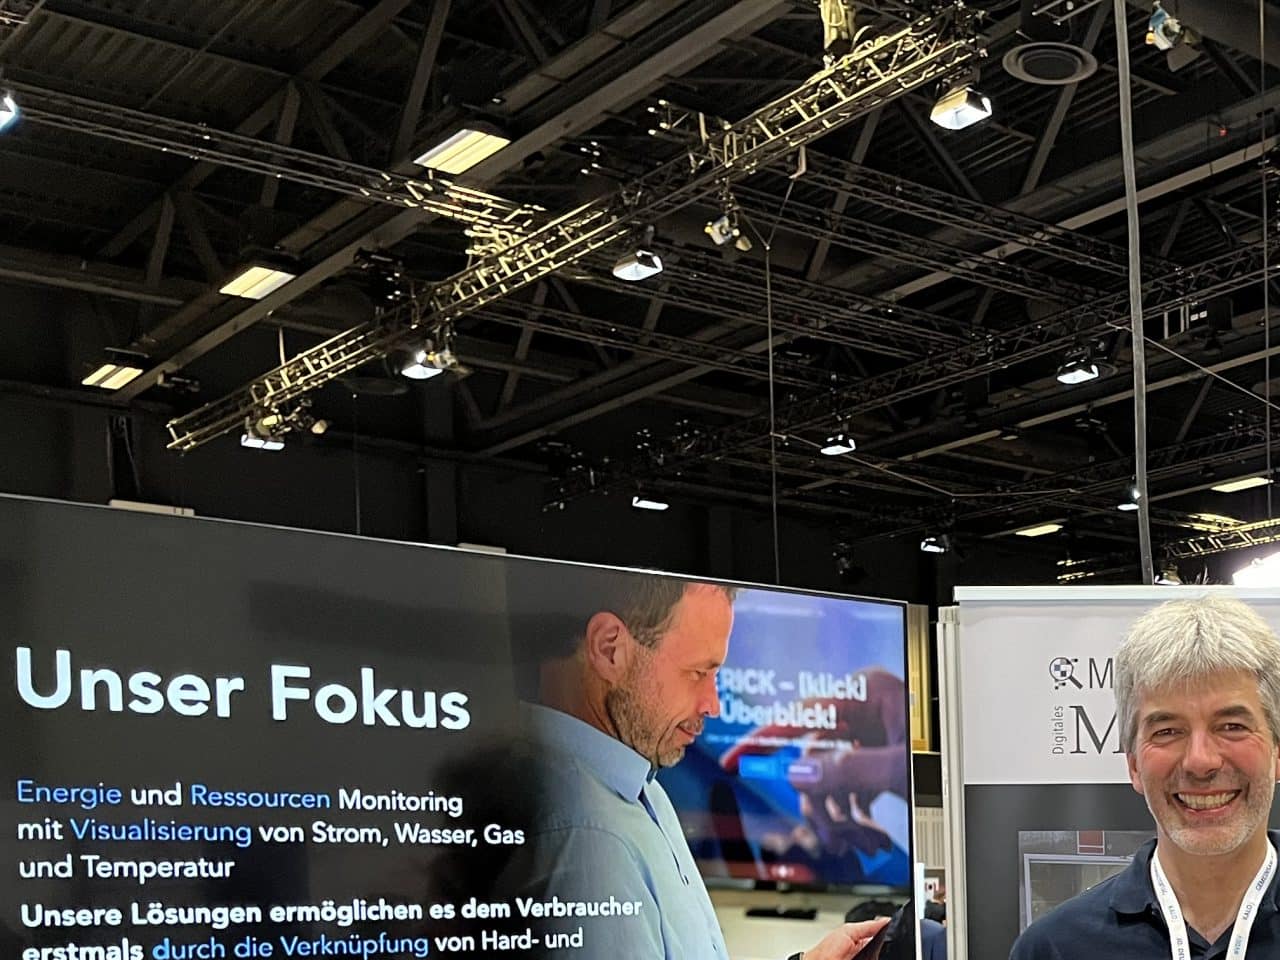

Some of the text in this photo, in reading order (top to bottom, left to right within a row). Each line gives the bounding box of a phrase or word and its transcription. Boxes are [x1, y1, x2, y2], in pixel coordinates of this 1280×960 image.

[15, 646, 471, 730] Unser Fokus
[1052, 704, 1065, 756] Digitales
[17, 779, 463, 817] Energie und Ressourcen Monitoring
[17, 818, 525, 848] mit Visualisierung von Strom, Wasser, Gas
[19, 854, 236, 885] und Temperatur
[20, 896, 643, 933] Unsere Lösungen ermöglichen es dem Verbraucher
[152, 935, 225, 960] durch
[233, 934, 273, 958] die
[434, 935, 475, 952] von
[481, 929, 540, 951] Hard-
[544, 927, 584, 950] und
